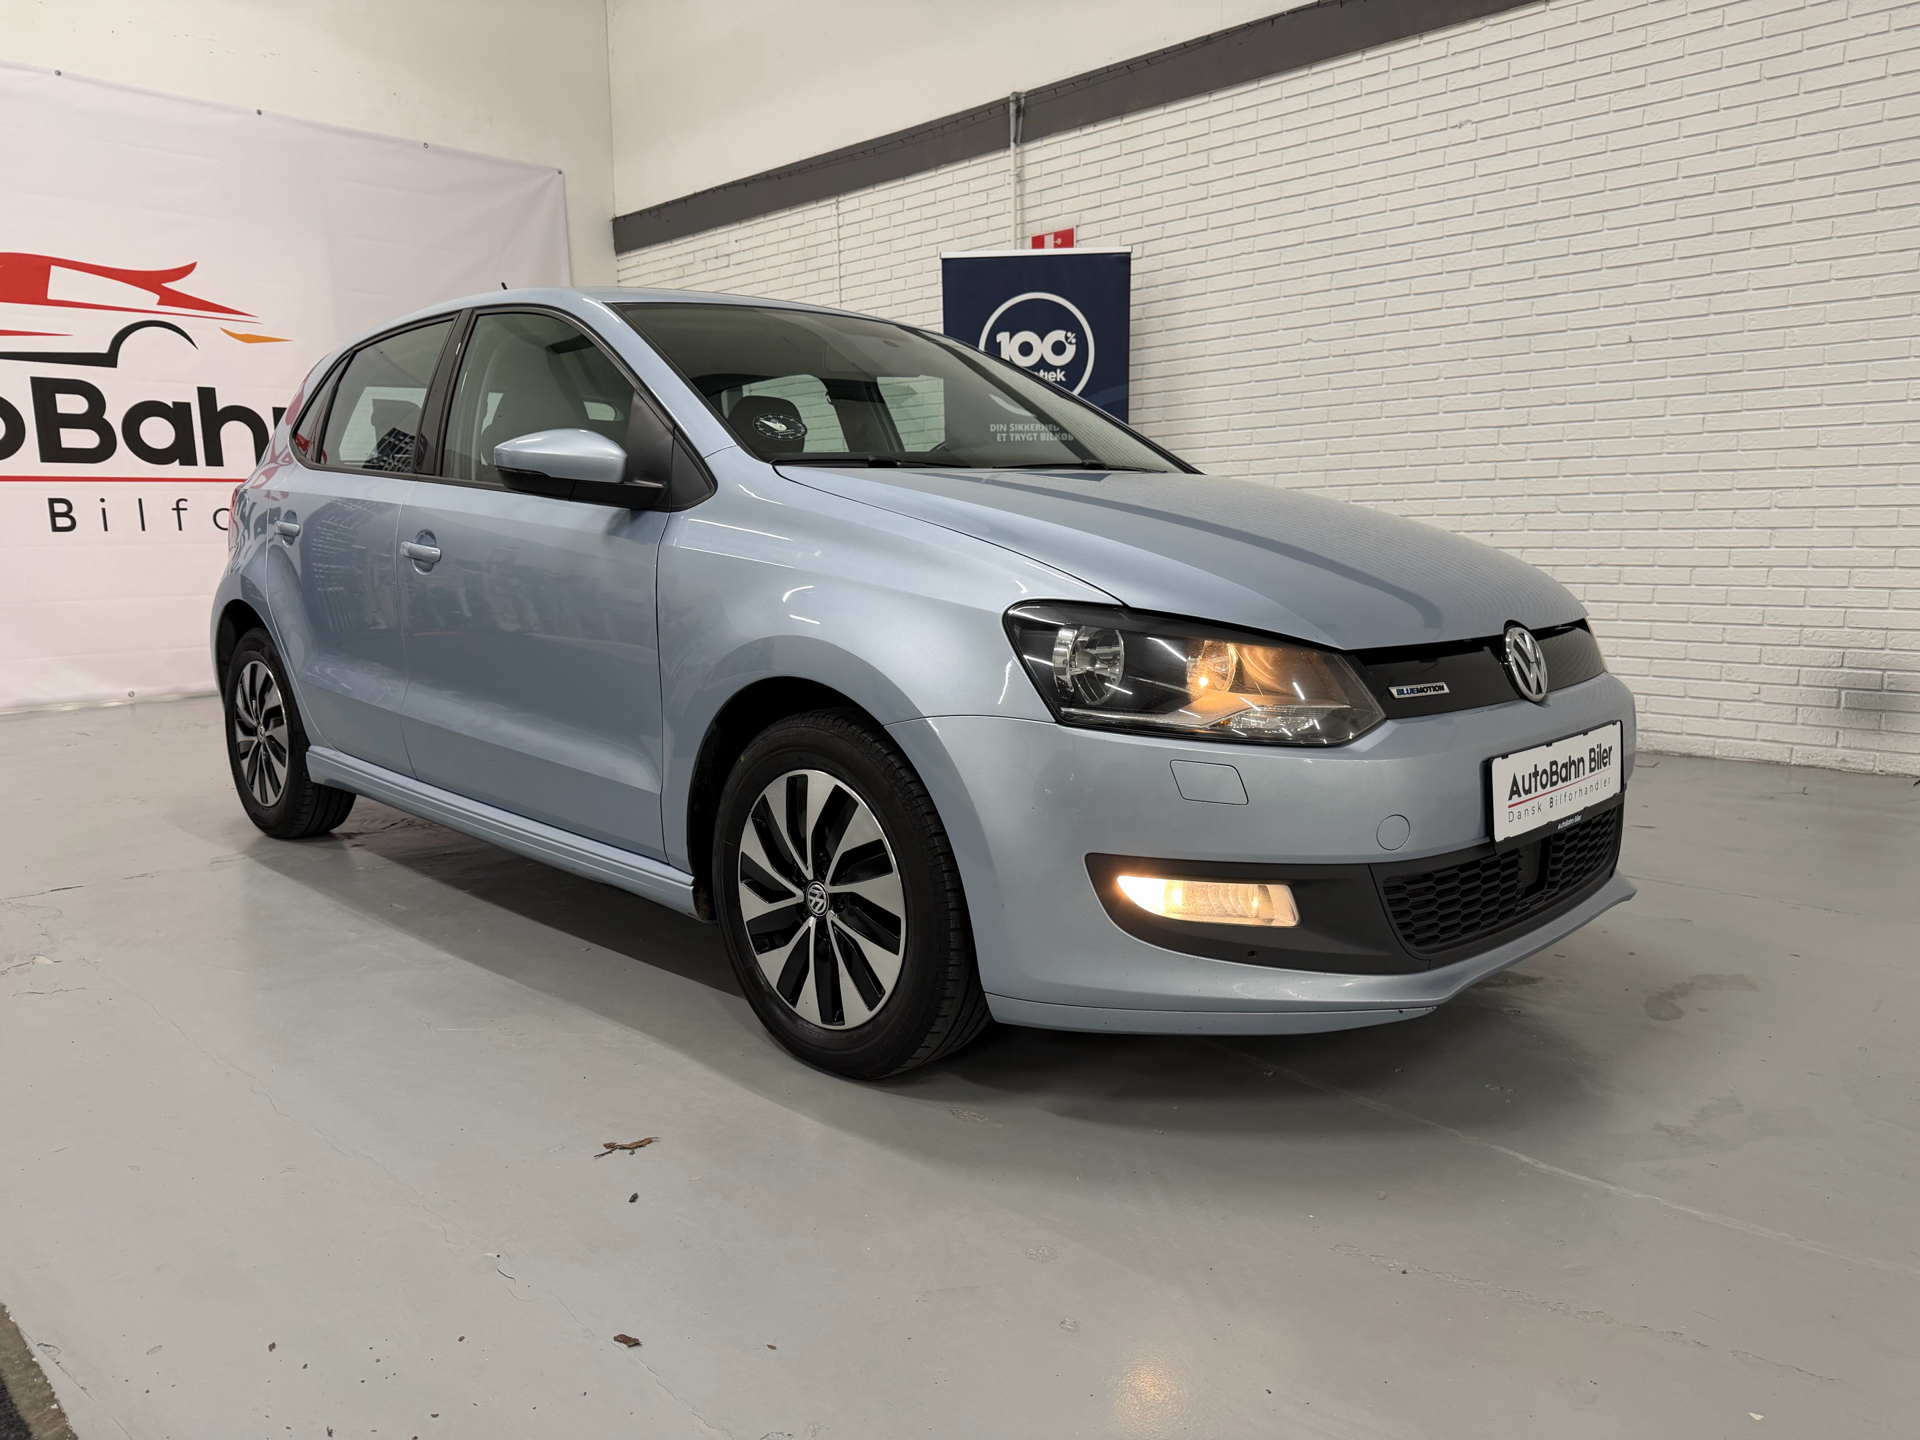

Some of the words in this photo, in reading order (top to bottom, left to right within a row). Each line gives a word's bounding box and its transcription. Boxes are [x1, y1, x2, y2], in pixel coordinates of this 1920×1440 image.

[990, 423, 1007, 432] DIN
[996, 433, 1007, 442] ET
[1009, 433, 1038, 442] TRYGT
[1396, 685, 1445, 696] BLUEMOTION
[1508, 755, 1586, 801] AutoBahn
[1589, 743, 1613, 774] Biler
[1508, 791, 1542, 823] Dansk
[1549, 776, 1612, 809] Bilforhandler
